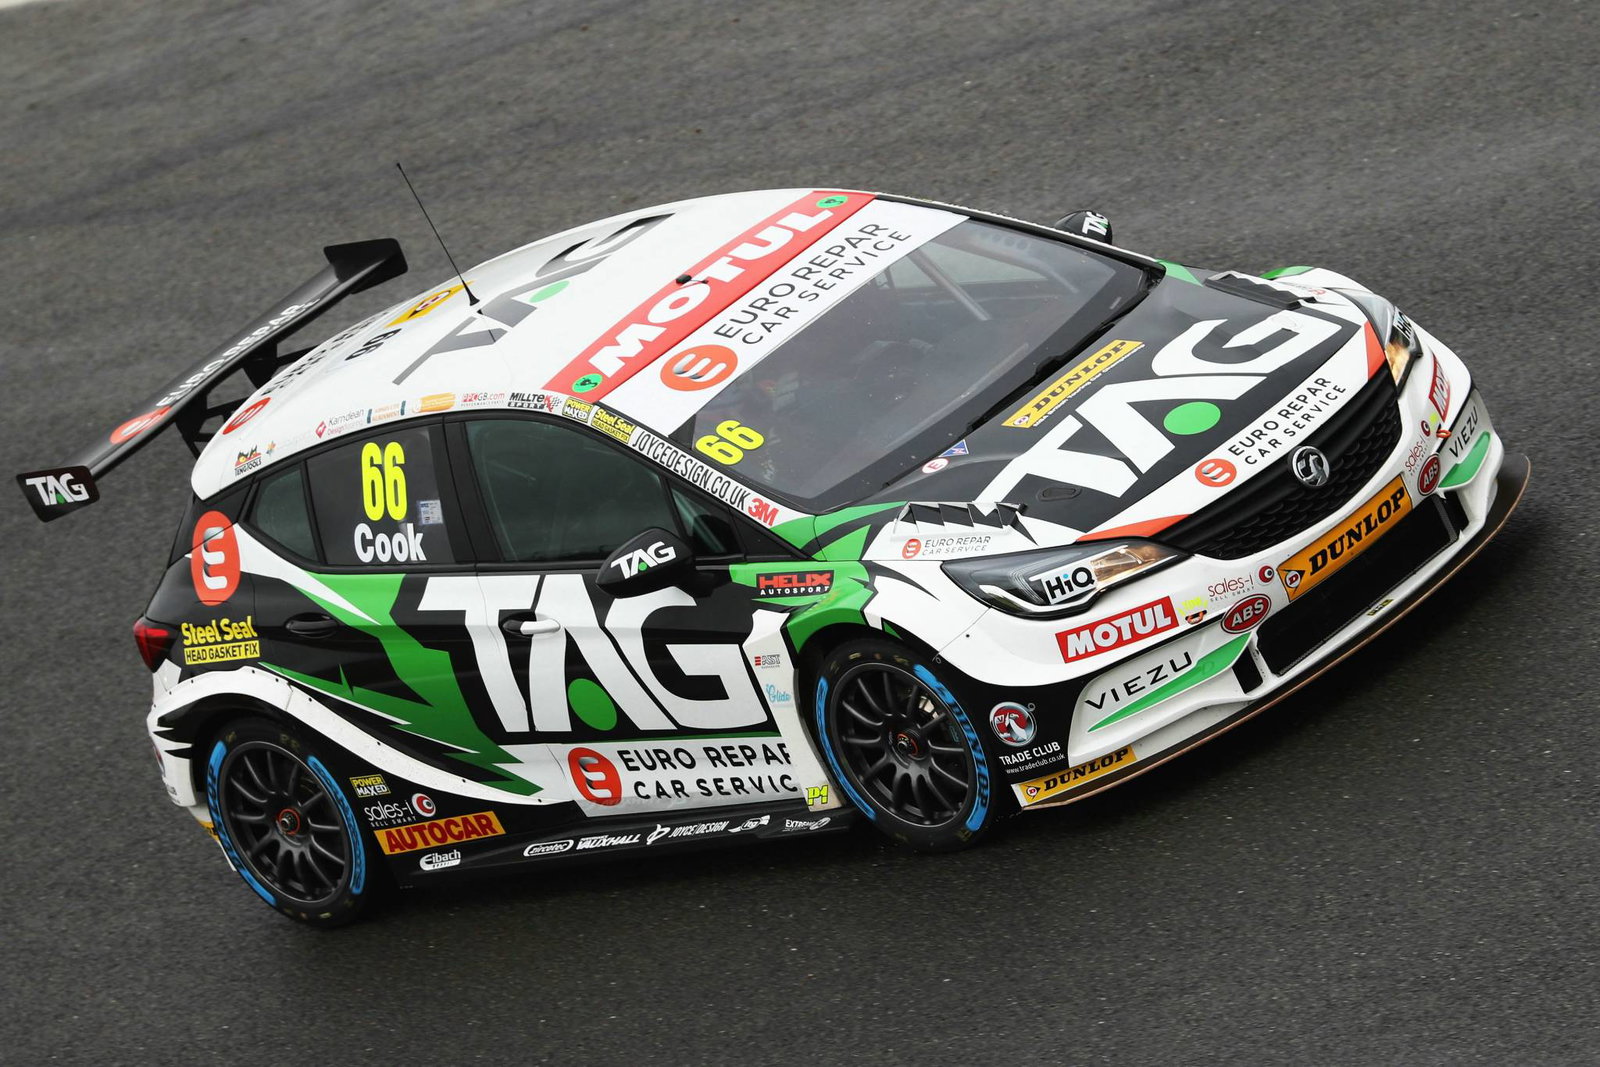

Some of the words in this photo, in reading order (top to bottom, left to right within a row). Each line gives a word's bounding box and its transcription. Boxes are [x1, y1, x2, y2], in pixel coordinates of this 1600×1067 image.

[589, 208, 835, 378] MOTUL
[714, 280, 797, 340] EURO
[791, 222, 890, 283] REPAR
[742, 305, 801, 346] CAR
[798, 230, 912, 306] SERVICE
[1031, 341, 1127, 412] DUNLOP
[564, 407, 588, 420] MAXED
[566, 399, 591, 413] POWER
[595, 408, 617, 425] Steel
[614, 419, 637, 435] Seal
[974, 309, 1343, 516] TAG
[1228, 420, 1279, 457] EURO
[1277, 377, 1332, 419] REPAR
[592, 419, 606, 431] HEAD
[603, 424, 622, 439] GASKET
[1245, 438, 1282, 465] CAR
[1283, 385, 1347, 437] SERVICE
[1449, 406, 1478, 458] VIEZU
[696, 420, 765, 466] 66
[361, 441, 407, 522] 66
[632, 431, 751, 511] JOYCEDESIGN.CO.UK
[1423, 459, 1439, 489] ABS
[26, 473, 91, 506] TAG
[747, 497, 779, 527] 3M
[354, 522, 427, 563] Cook
[925, 538, 954, 548] EURO
[955, 536, 991, 546] REPAR
[1308, 489, 1407, 576] DUNLOP
[610, 541, 677, 580] TAG
[944, 545, 987, 554] SERVICE
[758, 572, 832, 588] HELIX
[760, 586, 830, 596] AUTOSPORT
[1045, 566, 1095, 600] HiQ
[1231, 600, 1265, 627] ABS
[181, 619, 222, 646] Steel
[219, 615, 258, 641] Seal
[1067, 600, 1173, 660] MOTUL
[186, 648, 207, 663] HEAD
[208, 645, 243, 660] GASKET
[244, 642, 259, 656] FIX
[417, 574, 769, 733] TAG
[1085, 651, 1193, 710] VIEZU
[617, 746, 697, 773] EURO
[998, 749, 1033, 767] TRADE
[1032, 741, 1061, 757] CLUB
[1006, 752, 1066, 775] www.tradeclub.co.uk
[353, 776, 384, 788] POWER
[1043, 748, 1129, 792] DUNLOP
[355, 784, 388, 797] MAXED
[633, 777, 695, 800] CAR
[385, 814, 498, 853] AUTOCAR
[392, 815, 418, 826] SMART
[576, 833, 642, 851] VAUXHALL
[420, 849, 462, 867] Eibach
